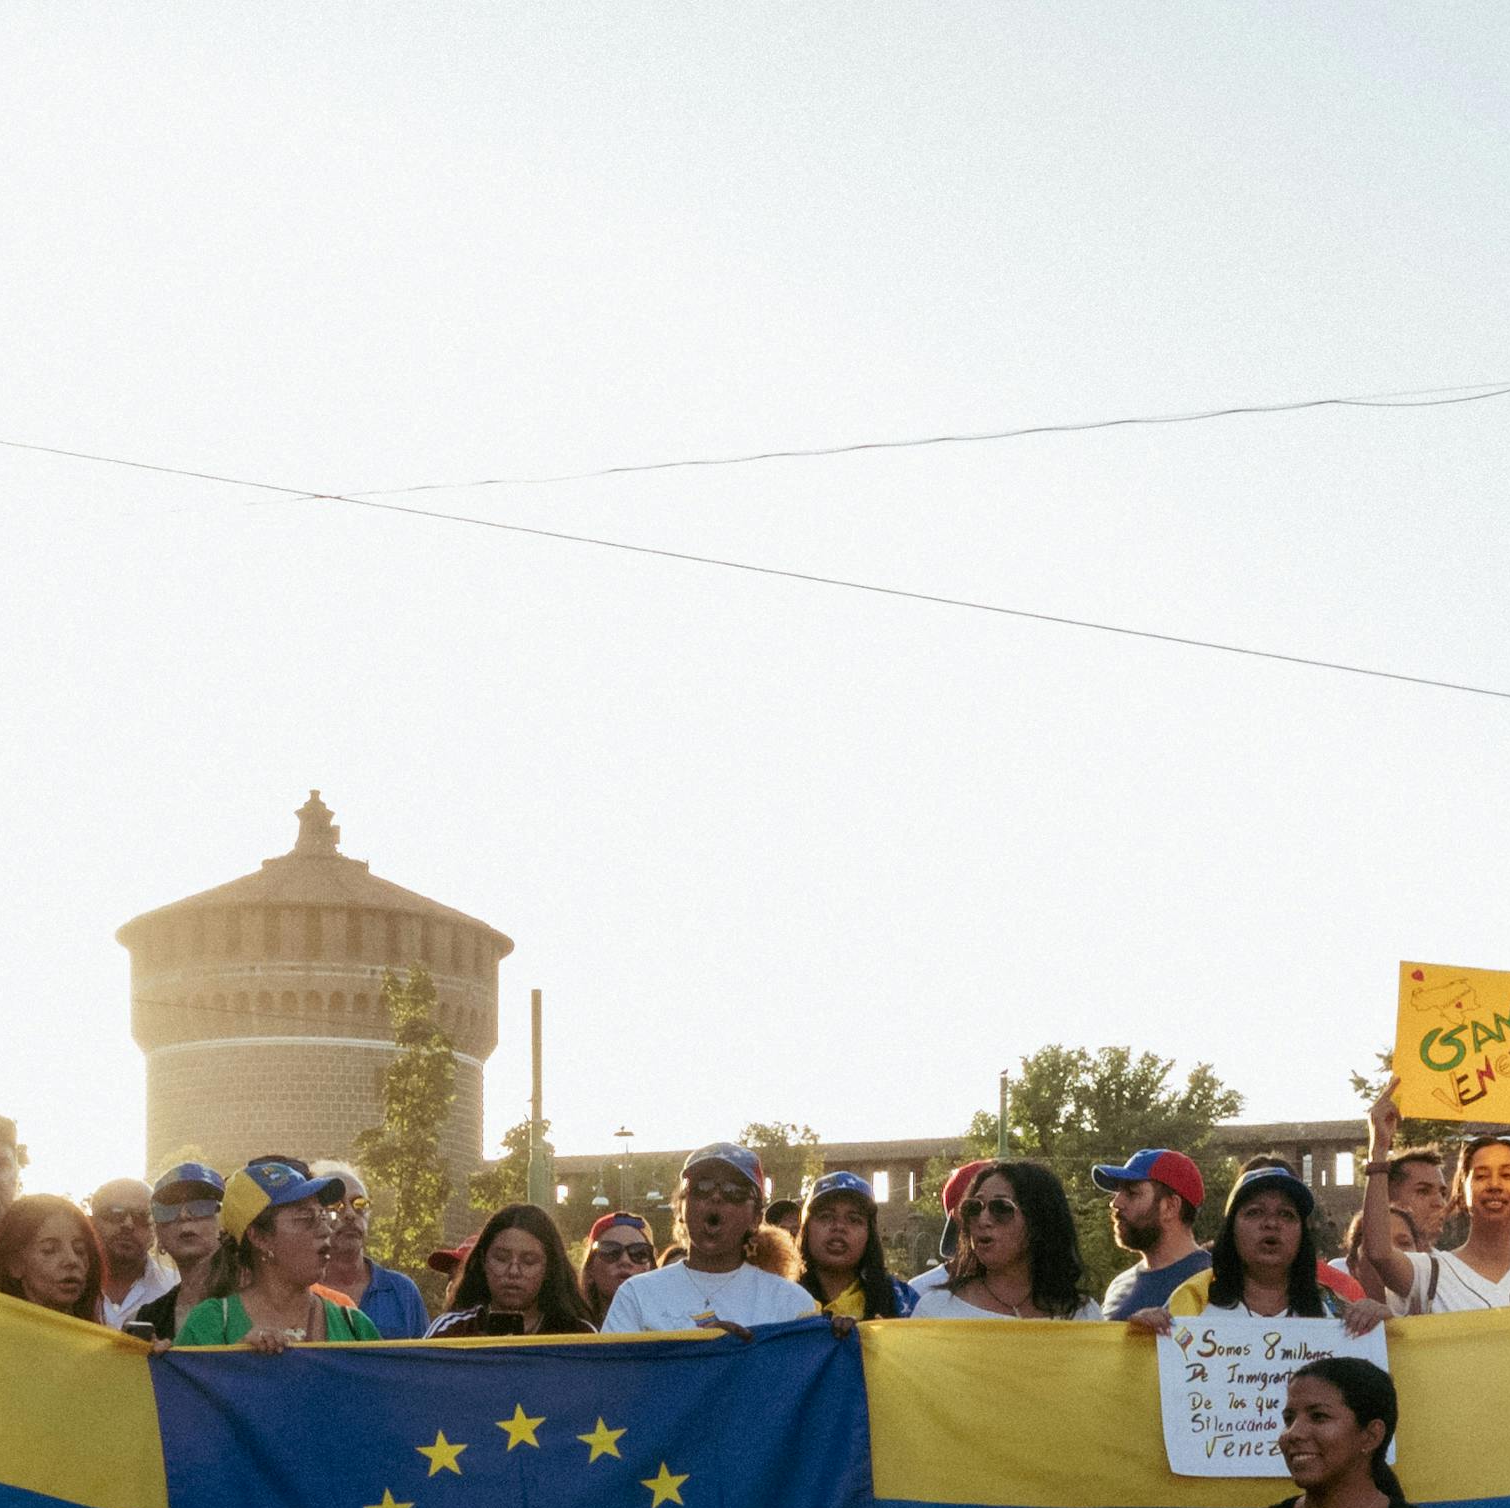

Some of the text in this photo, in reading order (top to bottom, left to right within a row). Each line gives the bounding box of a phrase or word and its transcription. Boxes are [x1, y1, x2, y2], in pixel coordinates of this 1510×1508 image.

[1197, 1329, 1251, 1358] Somos
[1263, 1331, 1281, 1360] 8
[1185, 1363, 1208, 1383] De
[1188, 1392, 1279, 1417] De los que
